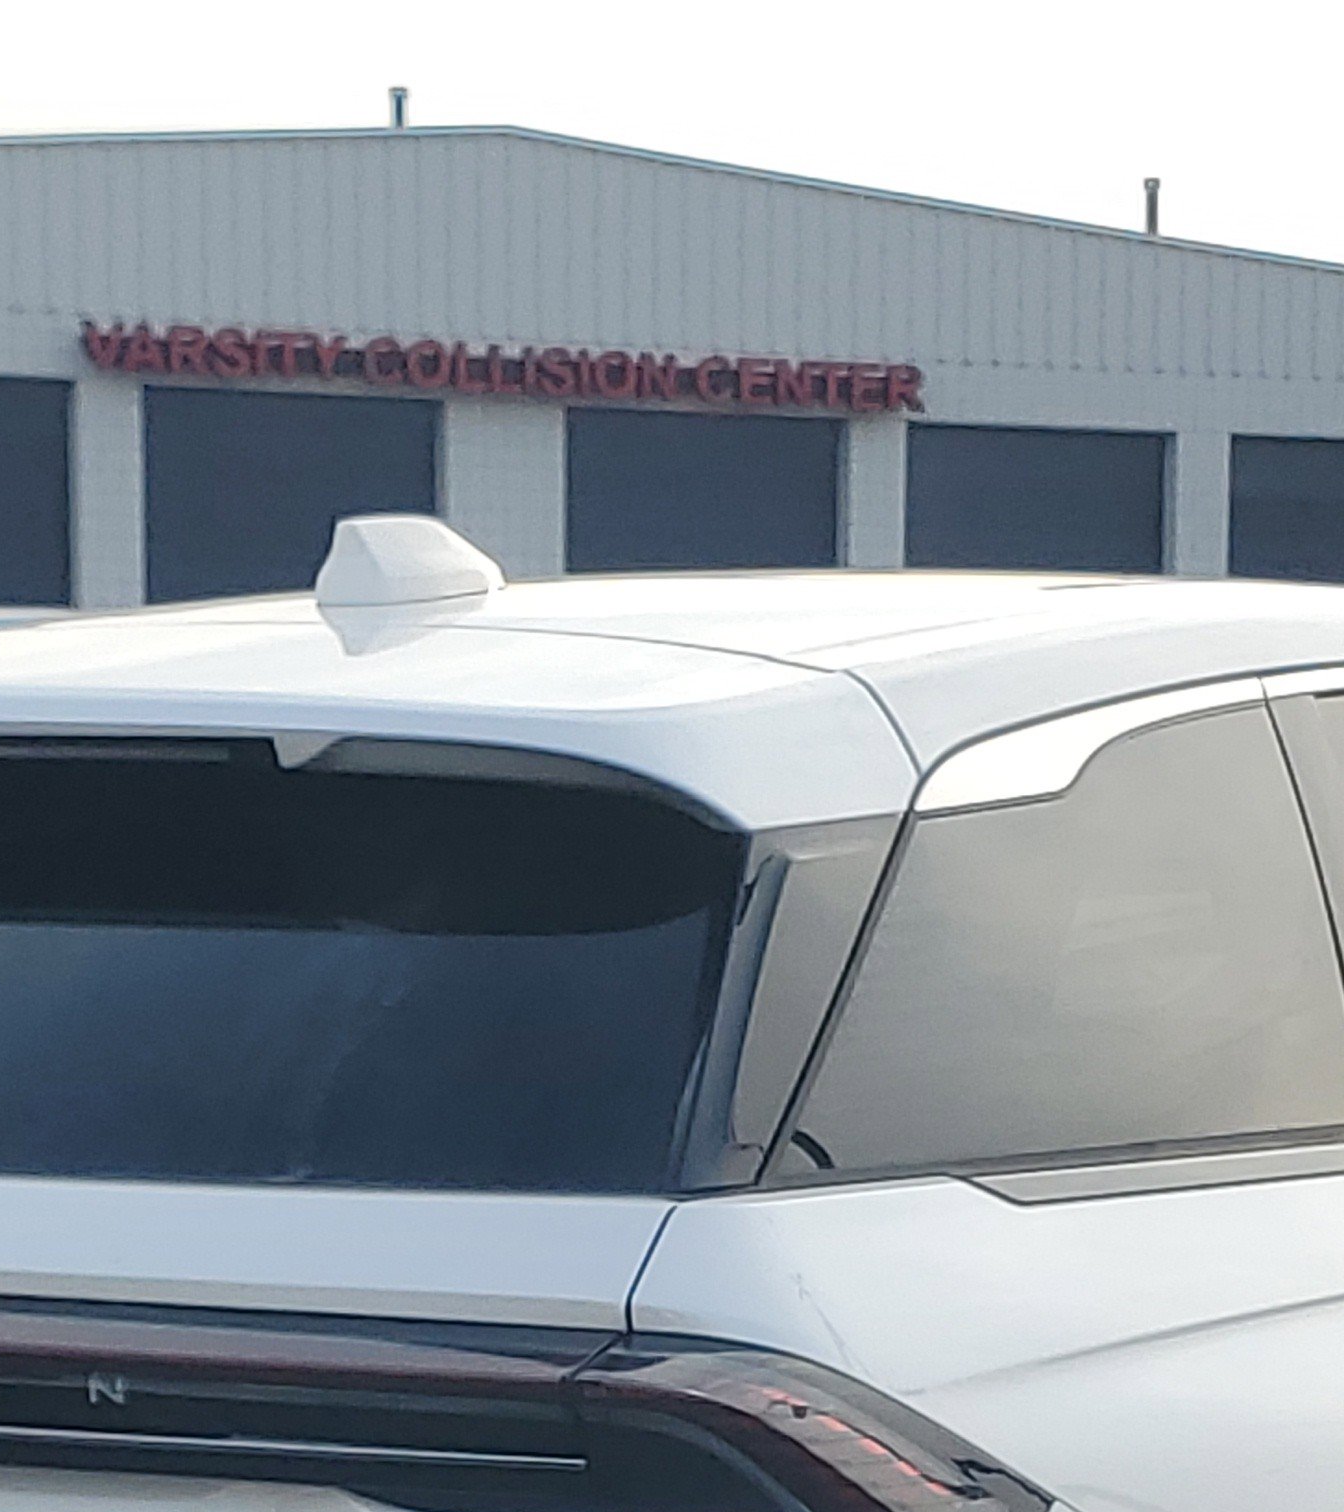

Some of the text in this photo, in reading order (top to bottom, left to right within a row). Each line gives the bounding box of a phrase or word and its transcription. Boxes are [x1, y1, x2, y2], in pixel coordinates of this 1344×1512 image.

[81, 321, 926, 413] VARSITY COLLISION CENTER
